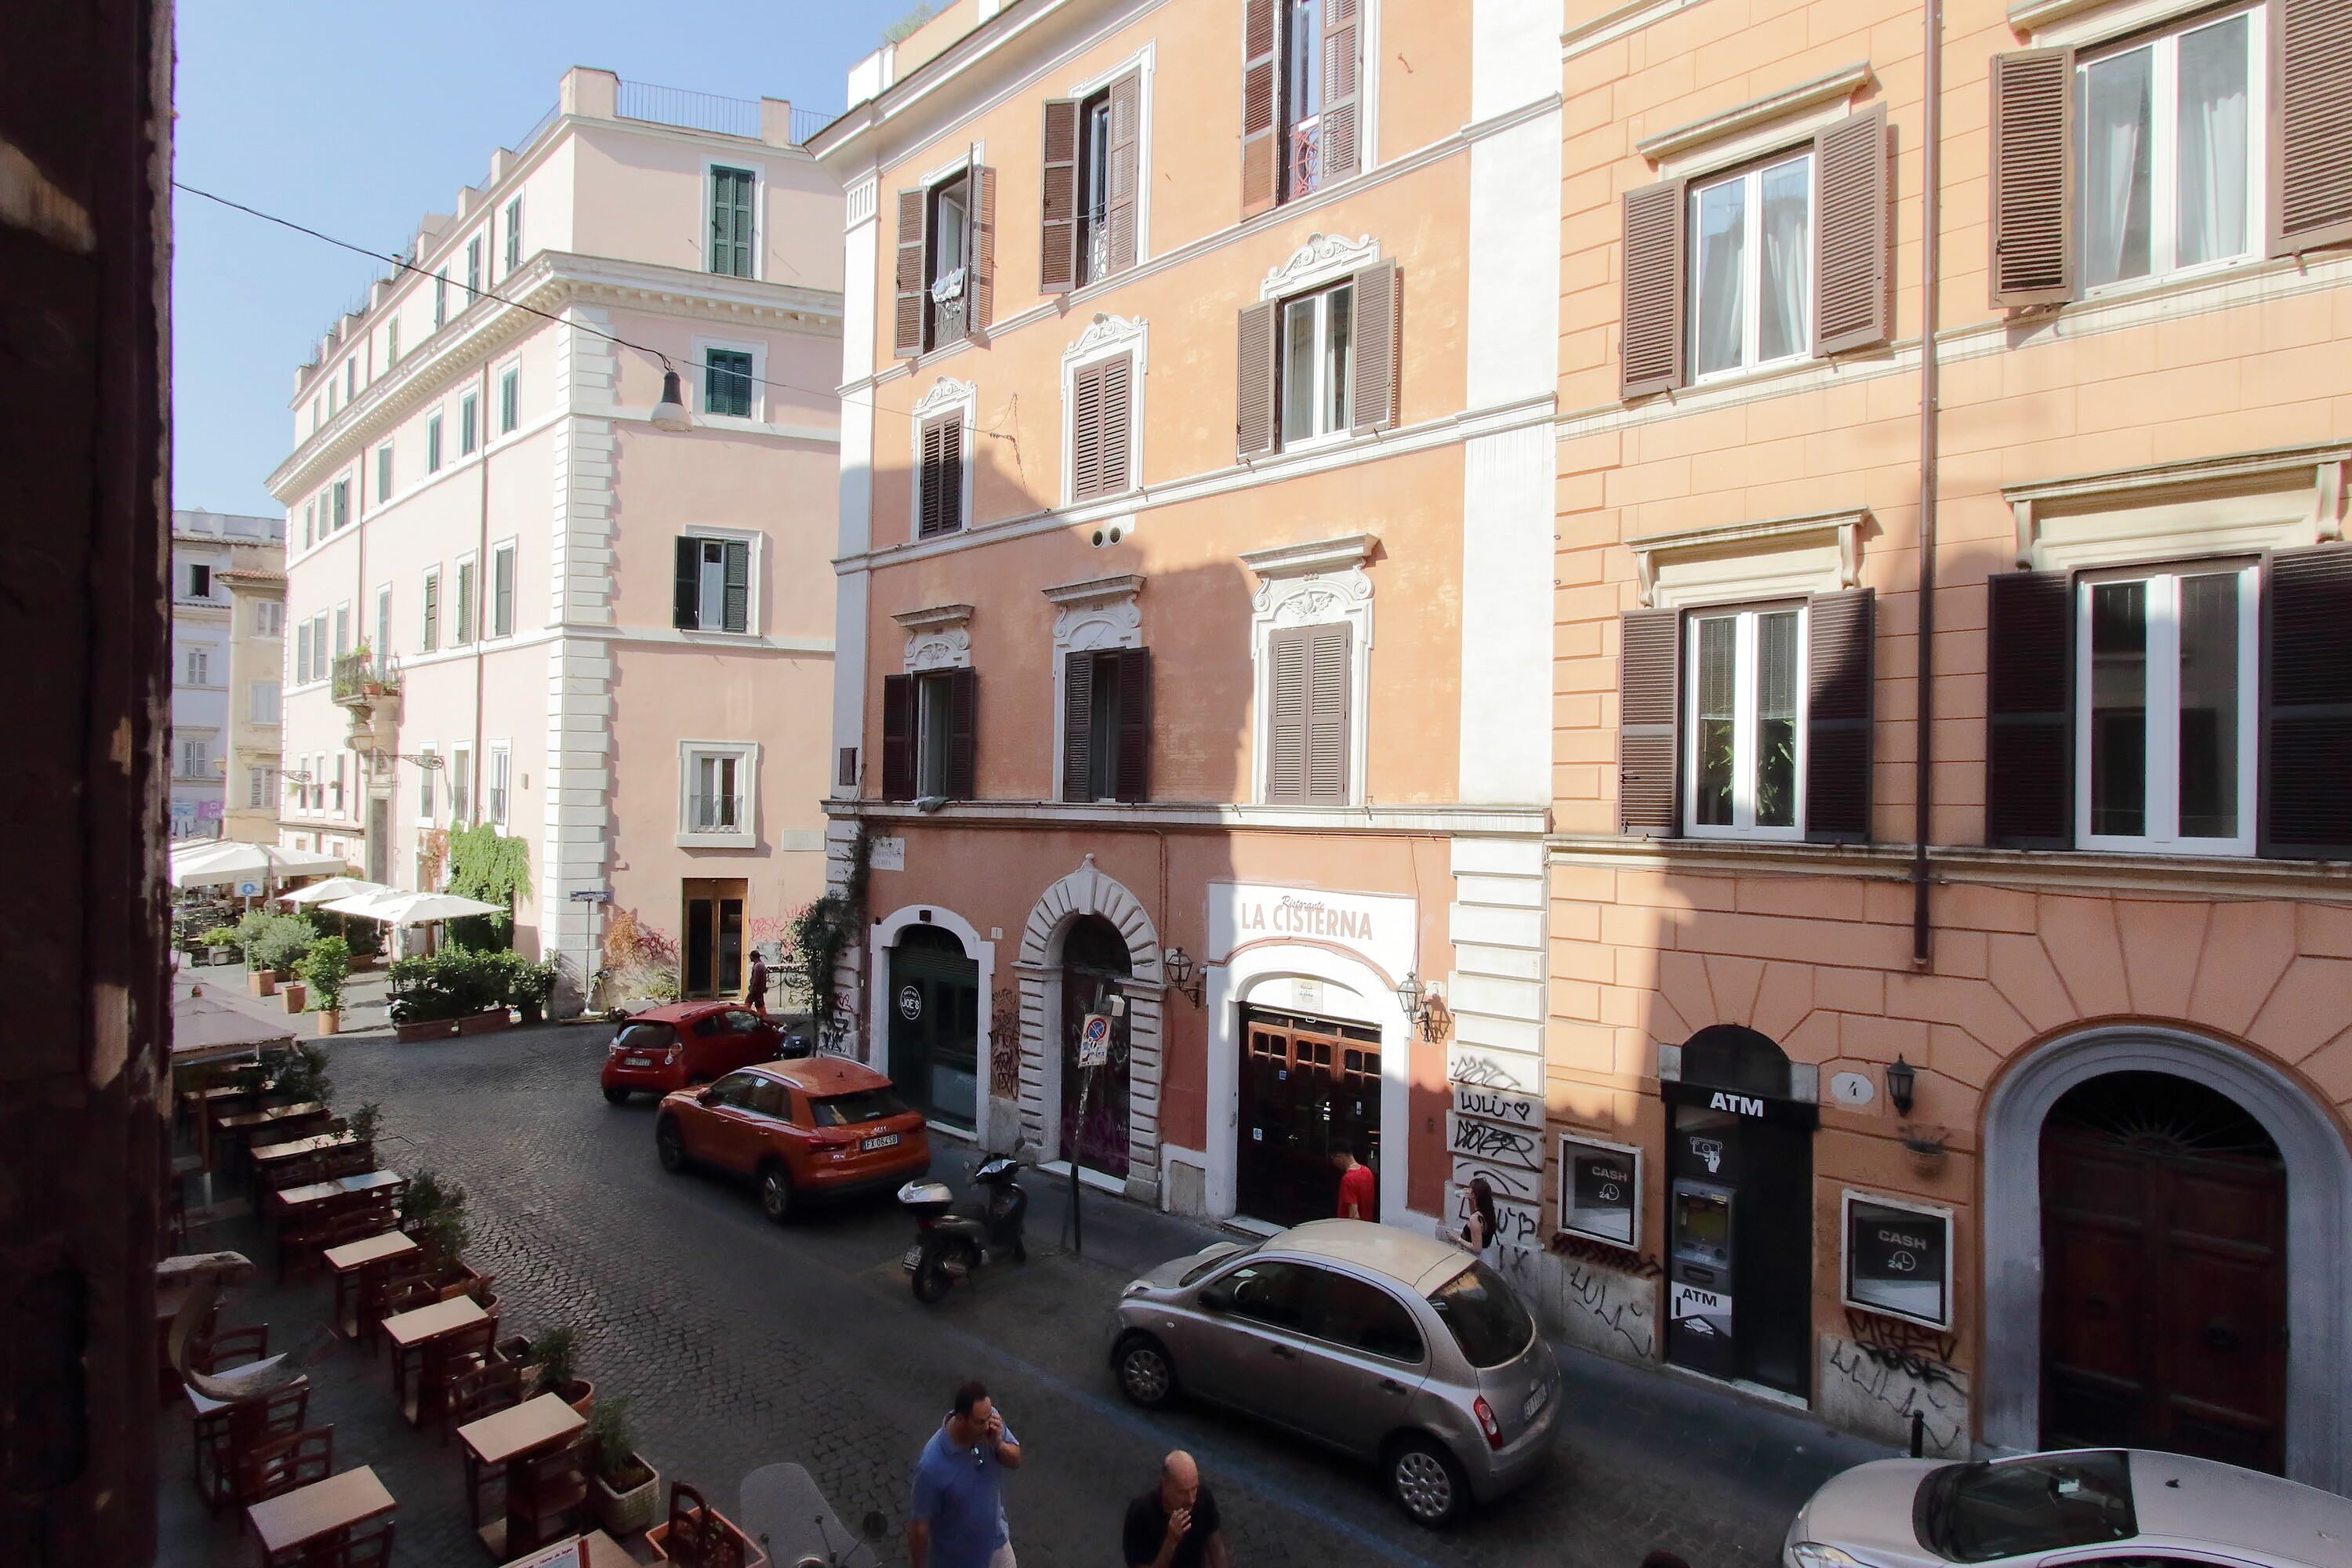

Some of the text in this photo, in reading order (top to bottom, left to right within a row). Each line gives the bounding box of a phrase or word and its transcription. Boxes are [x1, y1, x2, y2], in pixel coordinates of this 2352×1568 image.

[1281, 895, 1325, 911] Ristorante
[1242, 902, 1374, 941] LA CISTERNA
[1710, 1092, 1763, 1117] ATM
[1592, 1166, 1628, 1183] CASH
[1599, 1191, 1610, 1200] 24
[1878, 1229, 1927, 1250] CASH
[1888, 1259, 1904, 1271] 24
[1682, 1288, 1717, 1307] ATM
